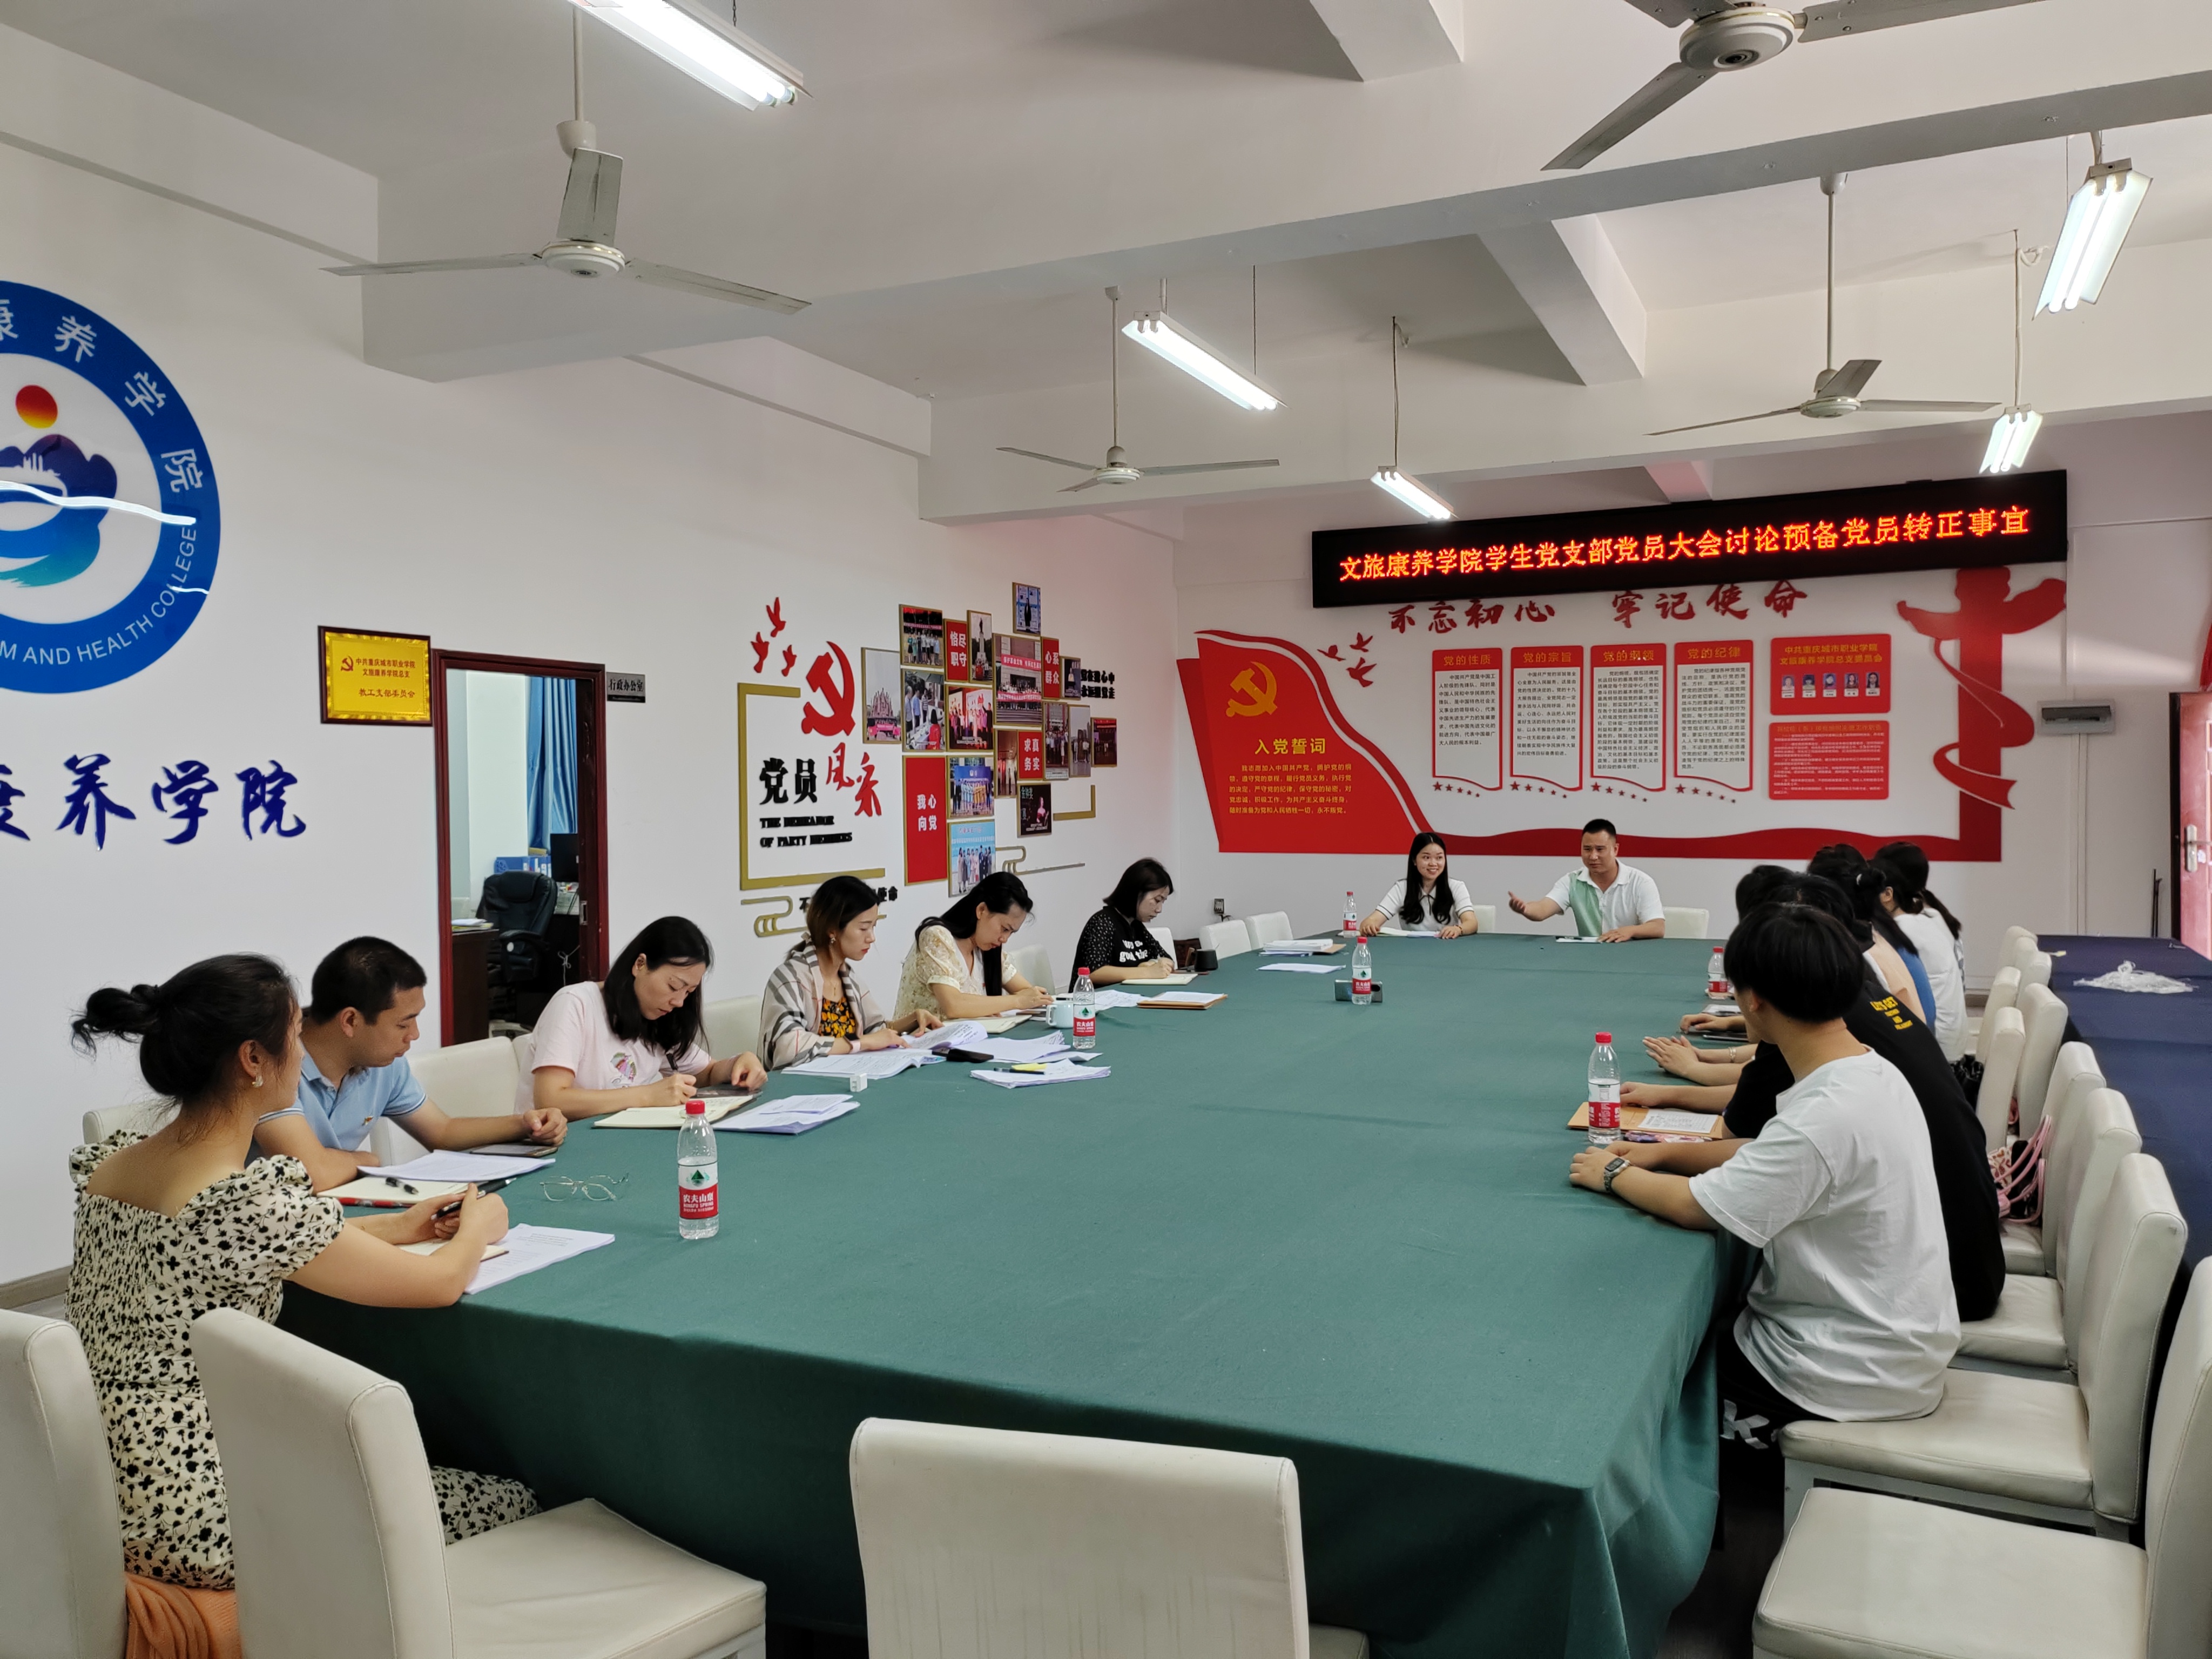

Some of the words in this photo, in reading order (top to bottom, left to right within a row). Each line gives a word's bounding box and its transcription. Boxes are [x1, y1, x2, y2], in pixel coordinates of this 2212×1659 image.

[1339, 505, 2029, 582] 文旅康养学院学生党支部党员大会讨论预备党员转正事宜
[1389, 599, 1555, 633] 不忘初心
[1613, 580, 1807, 628] 牢记使命
[23, 647, 70, 665] AND
[77, 614, 153, 662] HEALTH
[950, 631, 966, 648] 恪尽
[950, 651, 967, 667] 职守
[1045, 650, 1059, 665] 心系
[1444, 654, 1491, 666] 党的性质
[1523, 652, 1572, 663] 党的宗旨
[1688, 646, 1741, 659] 党的纪律
[356, 657, 415, 668] 中共重庆城市职业学院
[1045, 670, 1060, 685] 群众
[608, 679, 643, 692] 行政办公室
[1024, 738, 1040, 753] 求真
[1255, 738, 1325, 754] 入党誓词
[1024, 757, 1040, 772] 务实
[759, 757, 818, 805] 党员
[917, 794, 937, 810] 我心
[918, 815, 938, 832] 向党
[683, 1192, 713, 1203] 农夫山泉
